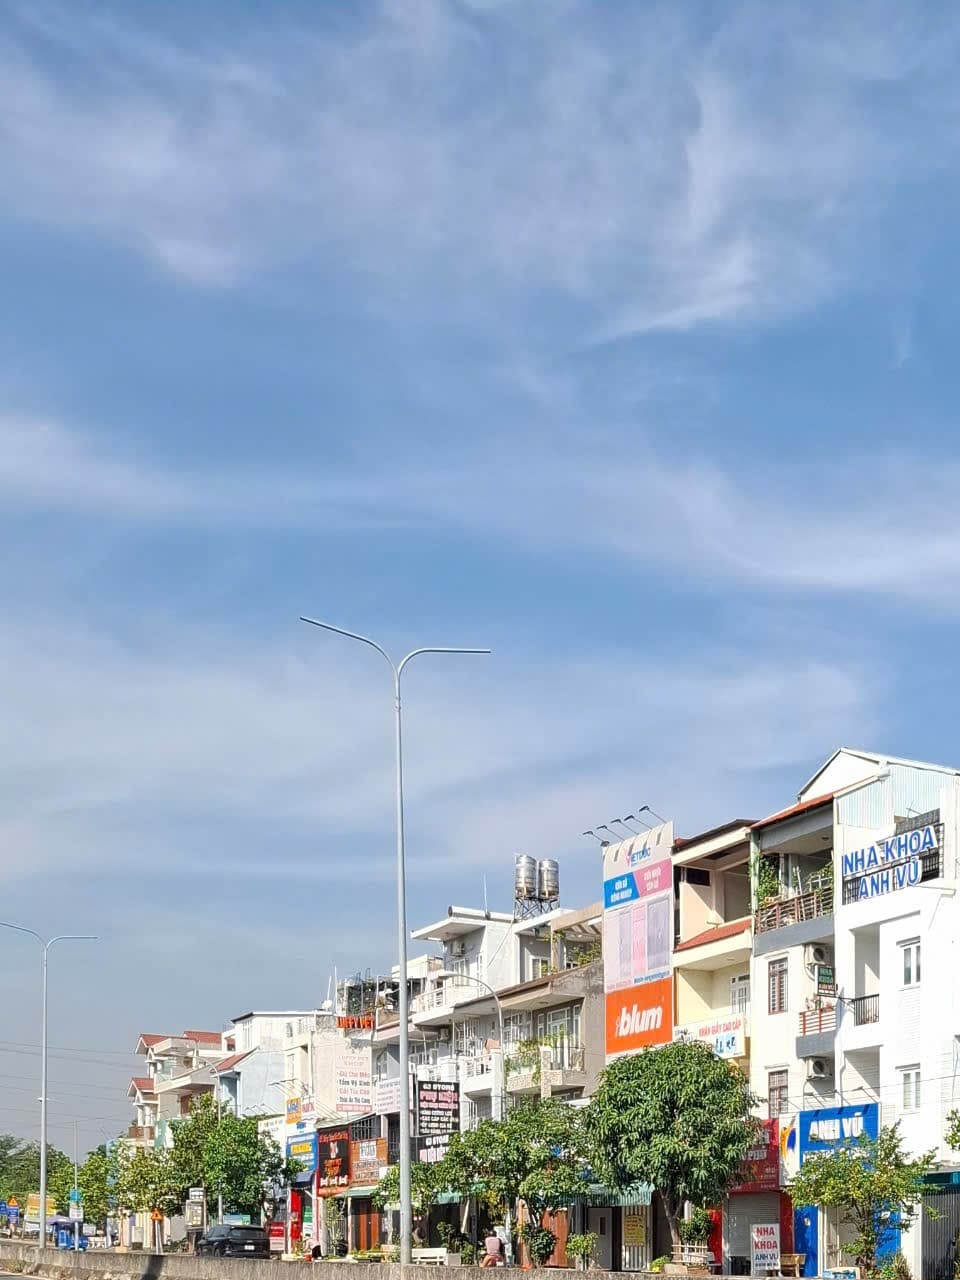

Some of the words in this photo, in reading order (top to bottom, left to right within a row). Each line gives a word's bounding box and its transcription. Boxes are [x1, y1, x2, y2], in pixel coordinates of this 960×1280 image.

[843, 845, 878, 875] NHA
[884, 826, 934, 862] KHOA
[859, 869, 889, 898] ANH
[620, 1004, 662, 1036] blum
[808, 1119, 840, 1141] ANH
[842, 1112, 864, 1138] VŨ
[754, 1240, 778, 1250] KHOA
[756, 1226, 775, 1236] NHA
